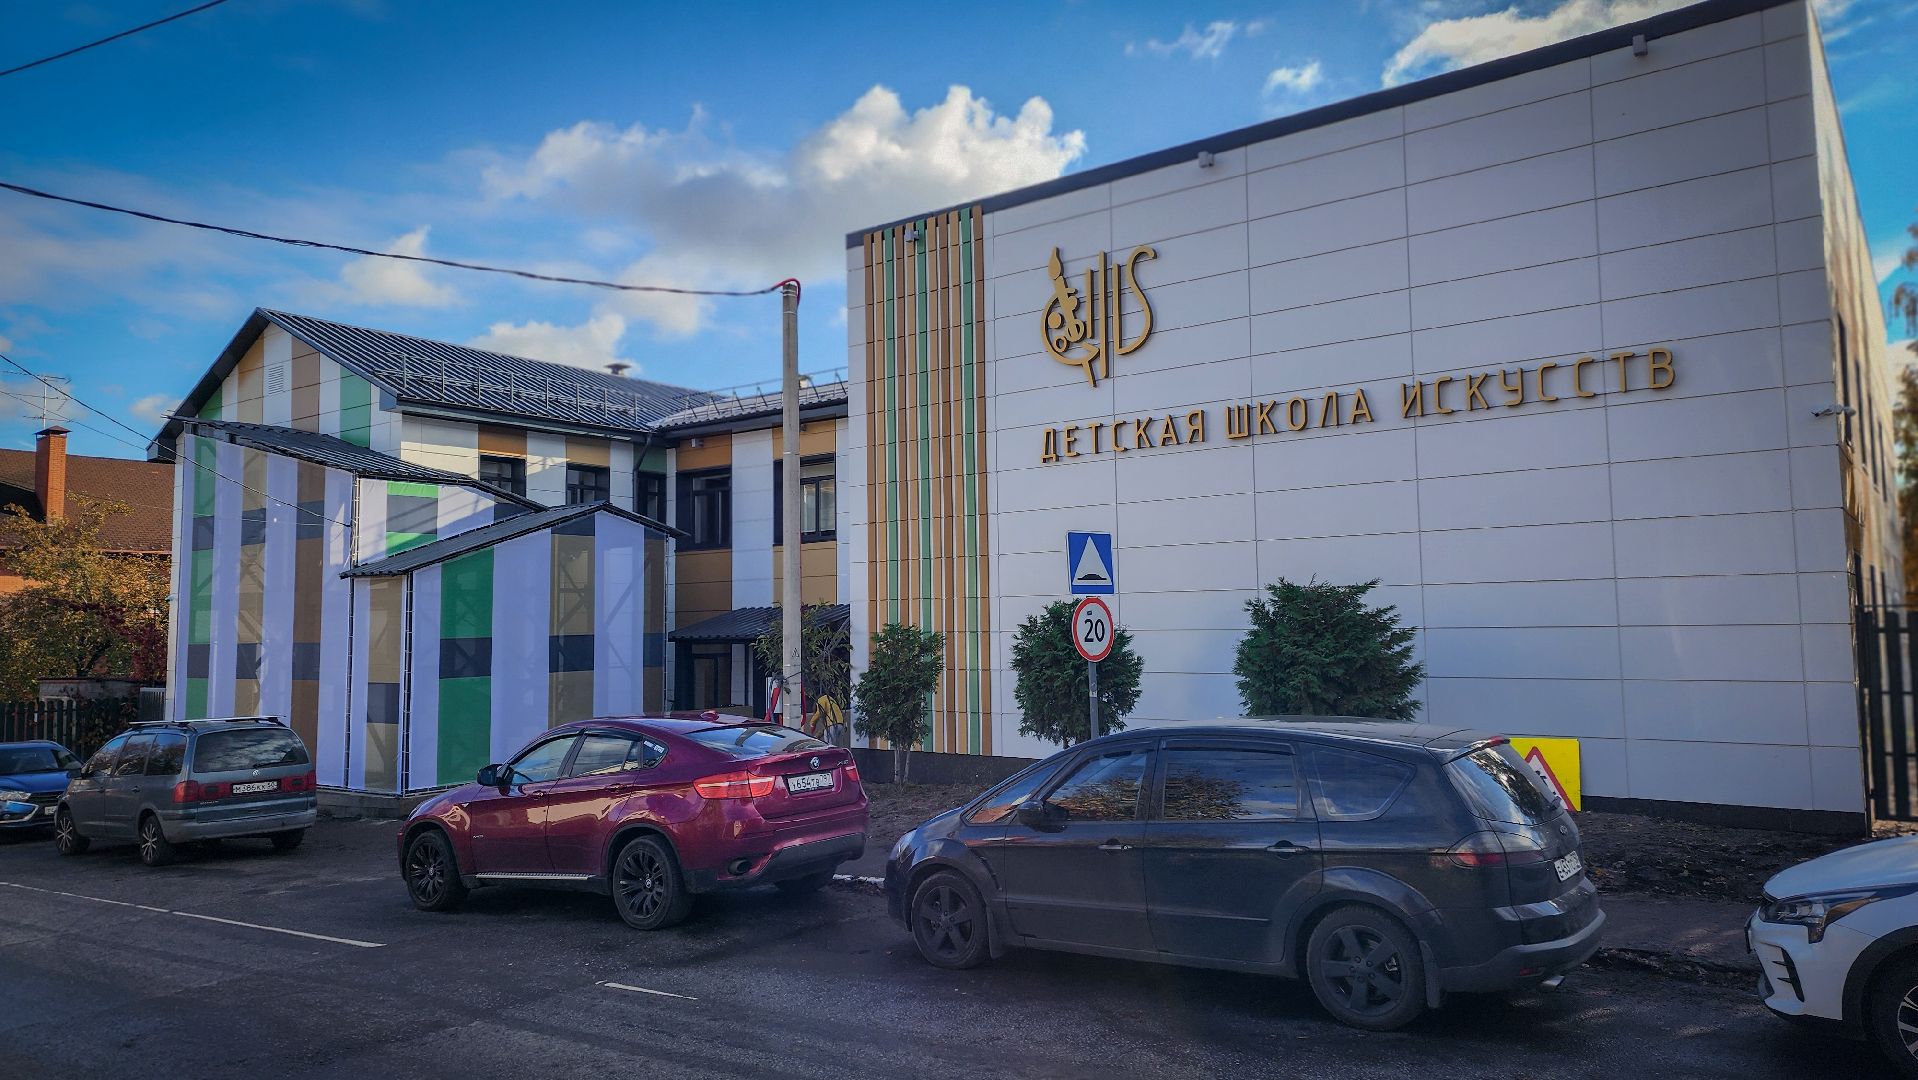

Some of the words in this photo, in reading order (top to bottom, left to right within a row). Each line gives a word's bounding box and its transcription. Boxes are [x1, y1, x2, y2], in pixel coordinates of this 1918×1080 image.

[1041, 409, 1205, 463] ДЕТСКАЯ
[1225, 387, 1375, 440] ШКОЛА
[1401, 348, 1676, 419] ИСКУССТВ
[1084, 618, 1105, 643] 20
